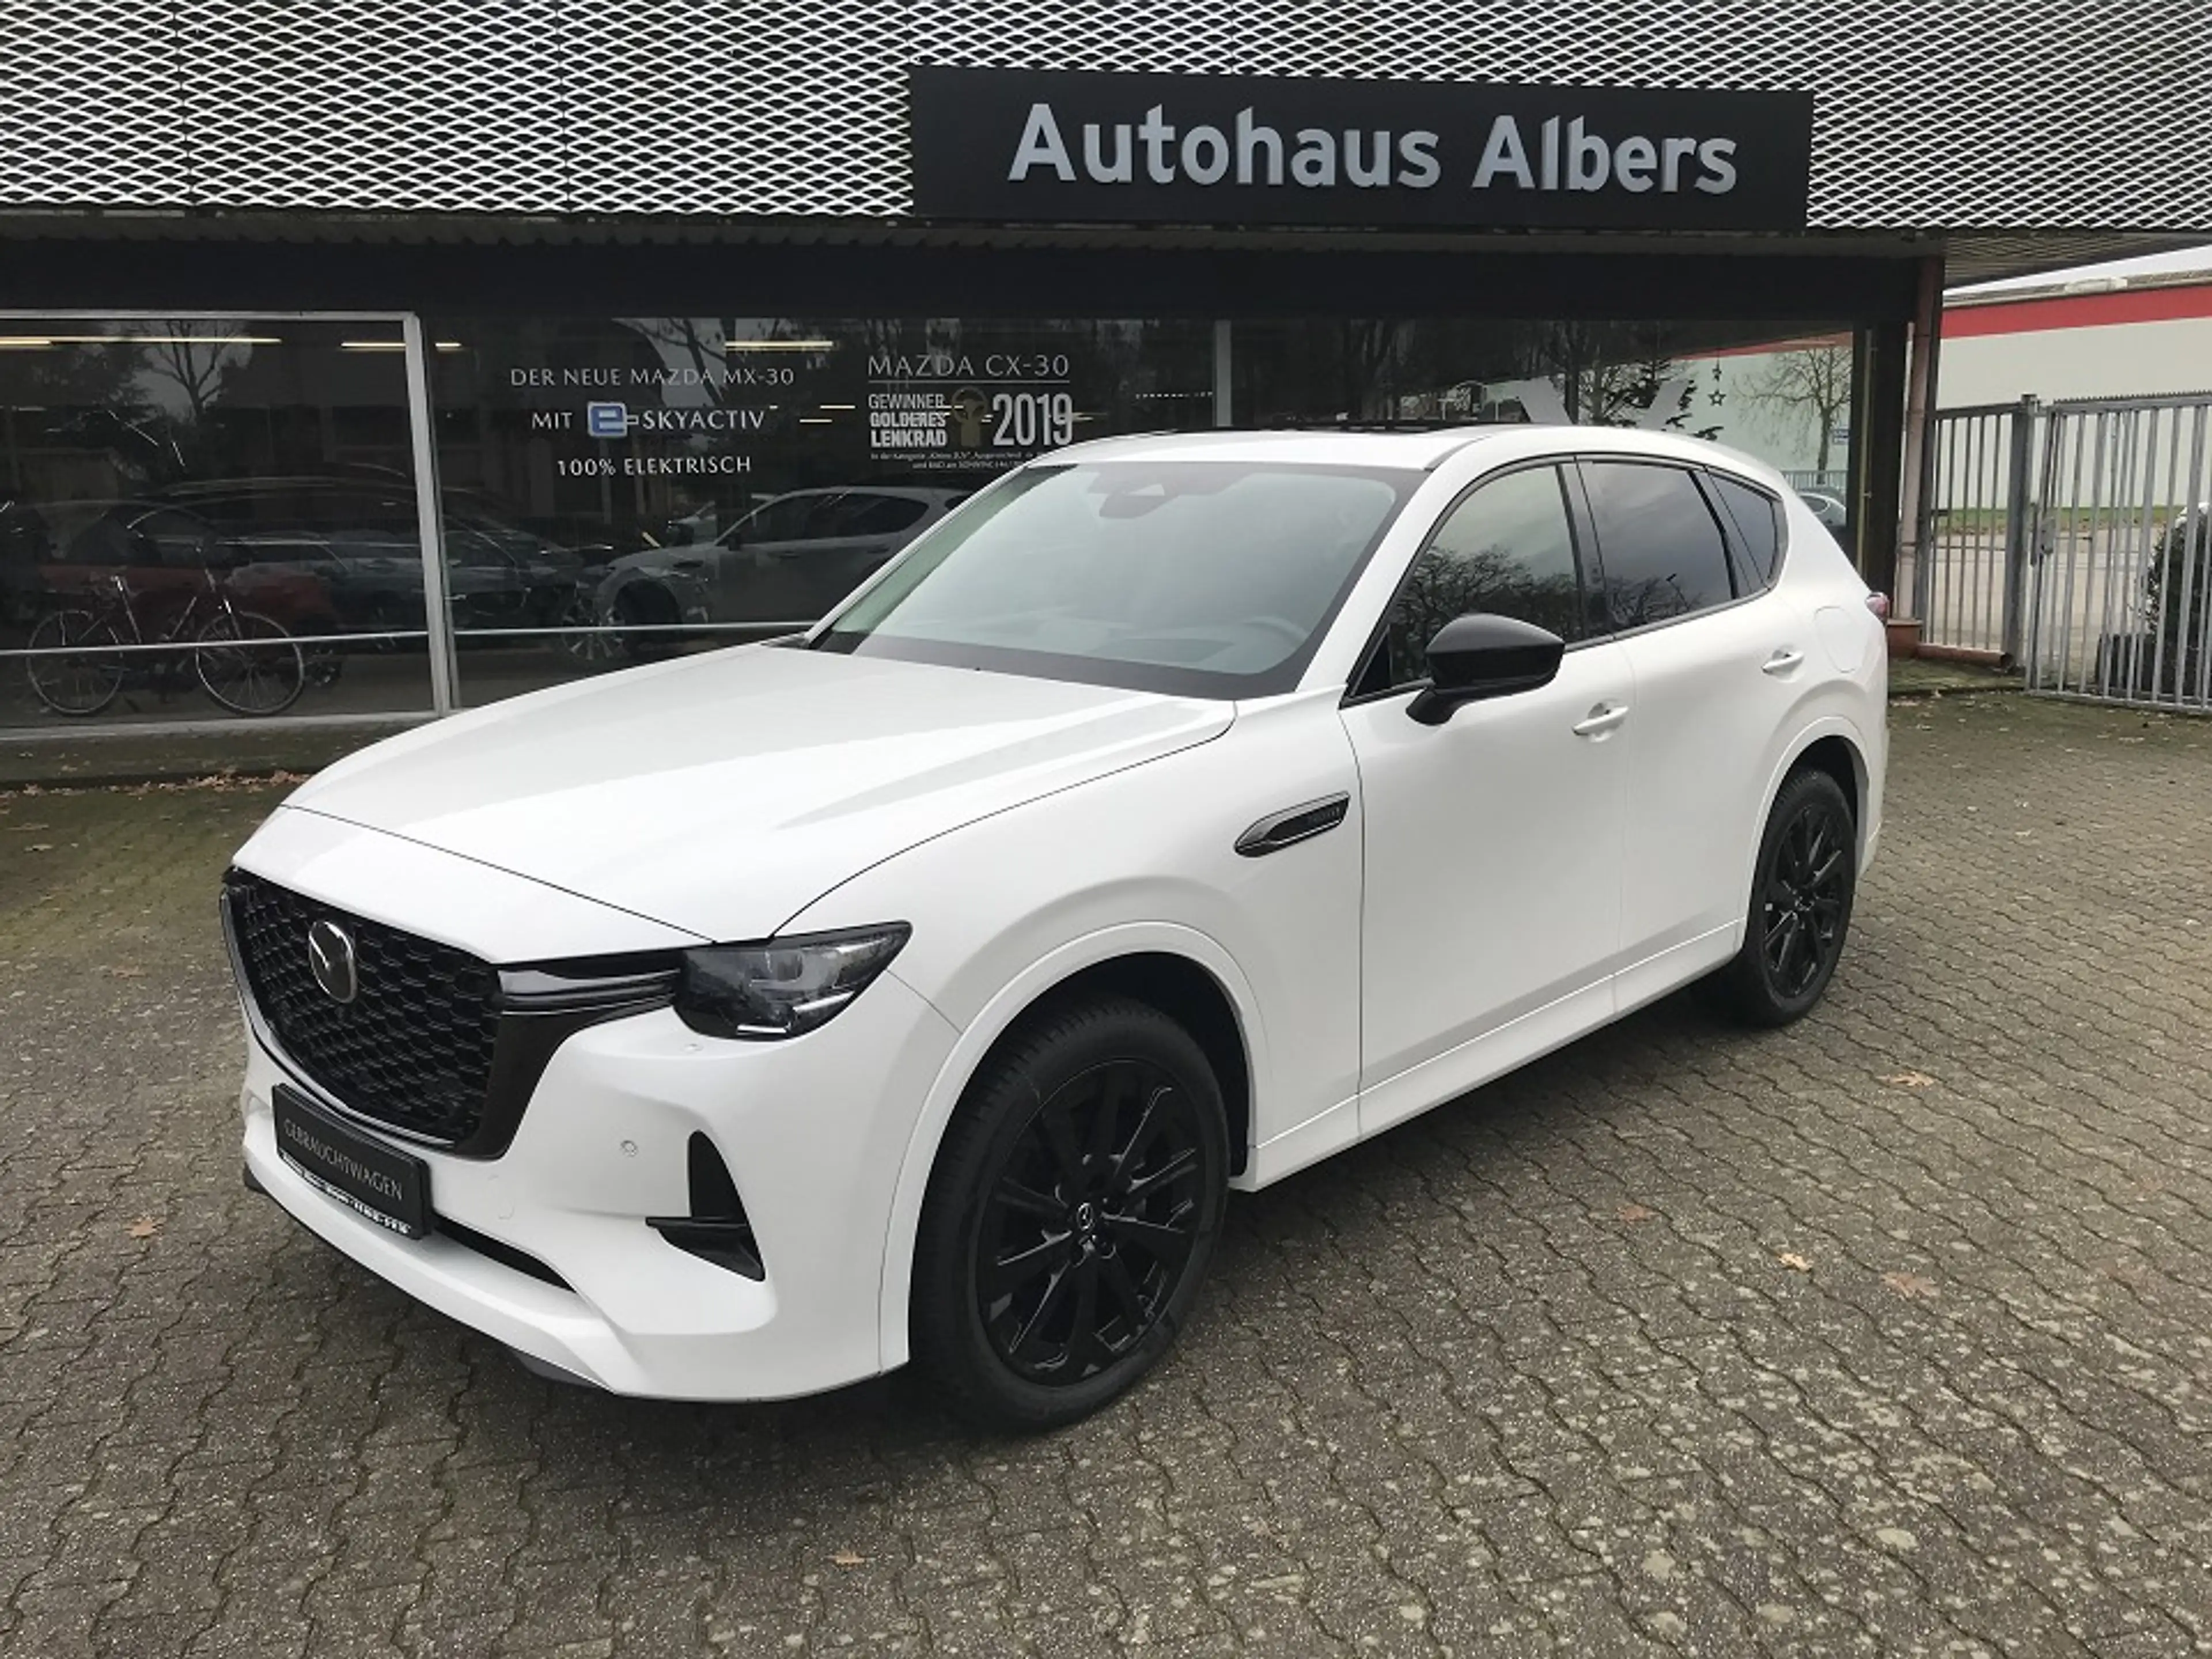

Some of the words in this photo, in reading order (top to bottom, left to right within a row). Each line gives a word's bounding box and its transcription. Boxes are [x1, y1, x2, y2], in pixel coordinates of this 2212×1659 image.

[1007, 103, 1441, 188] Autohaus
[1471, 115, 1737, 195] Albers
[868, 354, 976, 377] MAZDA
[985, 354, 1070, 377] CX-30
[510, 368, 556, 386] DER
[564, 368, 621, 386] NEUE
[630, 368, 714, 385] MAZDA
[722, 368, 795, 385] MX-30
[868, 393, 946, 410] GEWINNER
[531, 411, 573, 430] MIT
[992, 393, 1073, 446] 2019
[870, 429, 948, 448] LENKRAD
[557, 459, 616, 476] 100%
[624, 456, 751, 475] ELEKTRISCH
